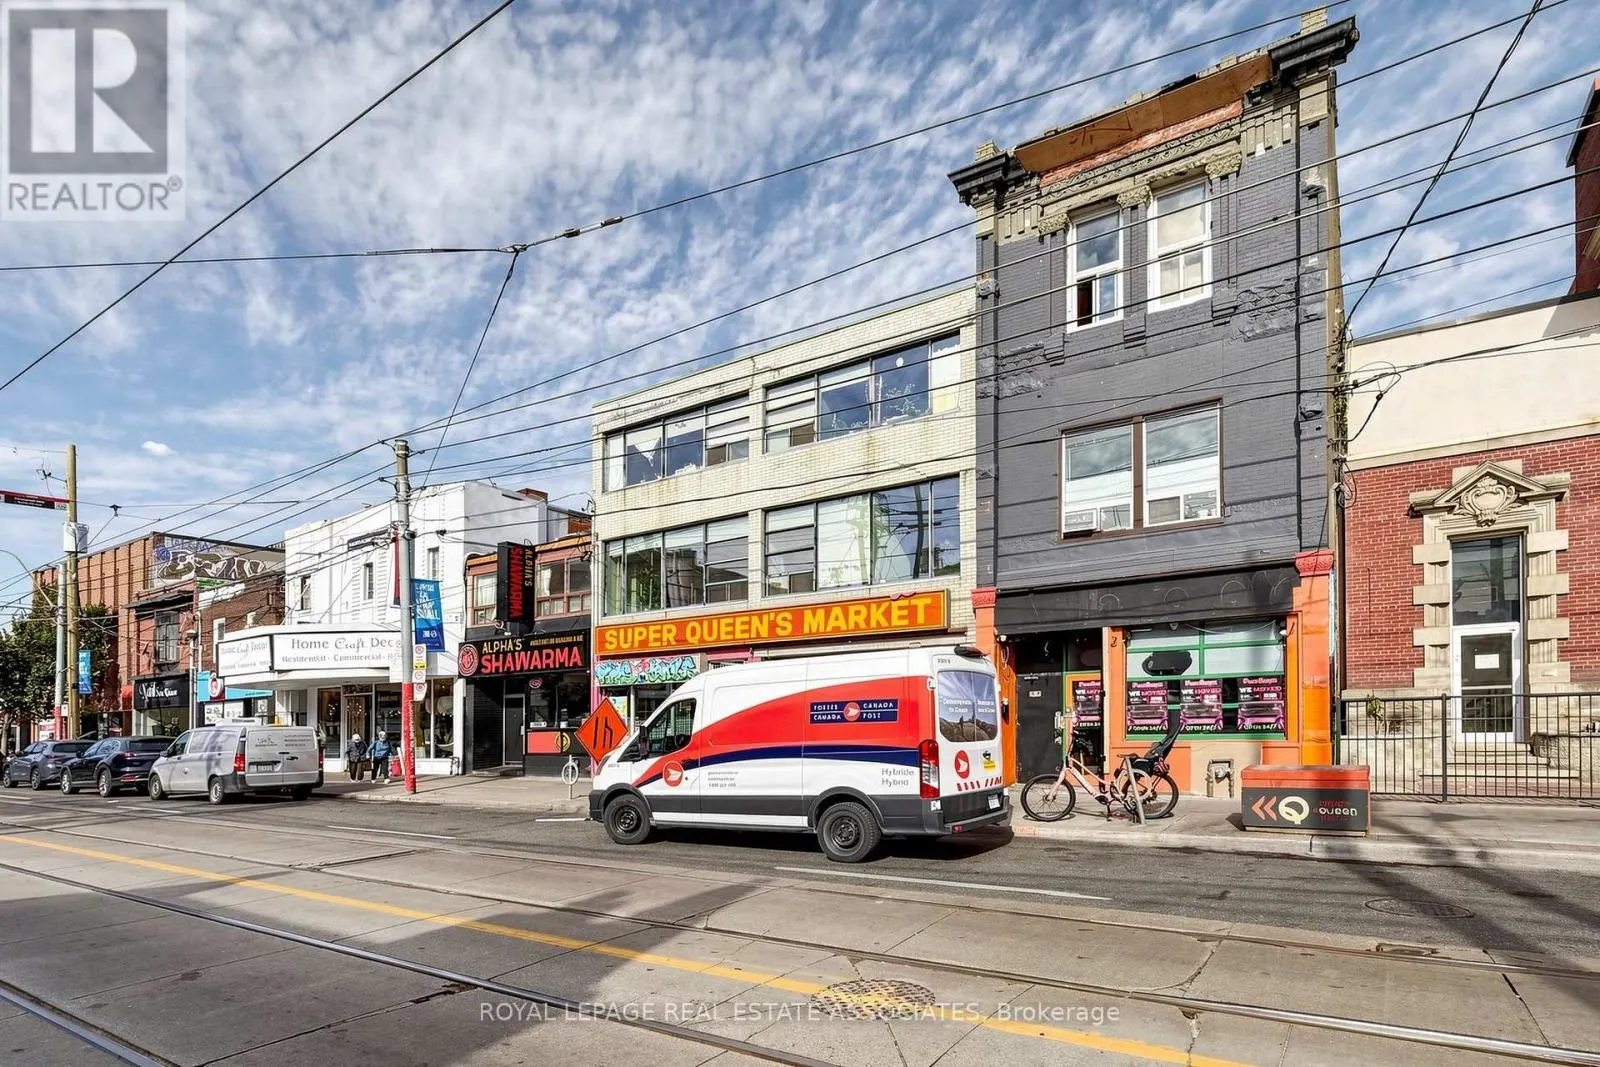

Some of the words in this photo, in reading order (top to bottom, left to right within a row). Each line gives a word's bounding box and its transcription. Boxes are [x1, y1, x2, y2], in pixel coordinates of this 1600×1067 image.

[510, 546, 523, 617] SHAWARMA
[604, 626, 677, 651] SUPER
[685, 611, 793, 645] QUEEN'S
[803, 599, 932, 635] MARKET
[291, 638, 329, 650] Home
[482, 639, 523, 654] ALPHA'S
[481, 646, 583, 674] SHAWARMA
[881, 778, 909, 788] Hybrid
